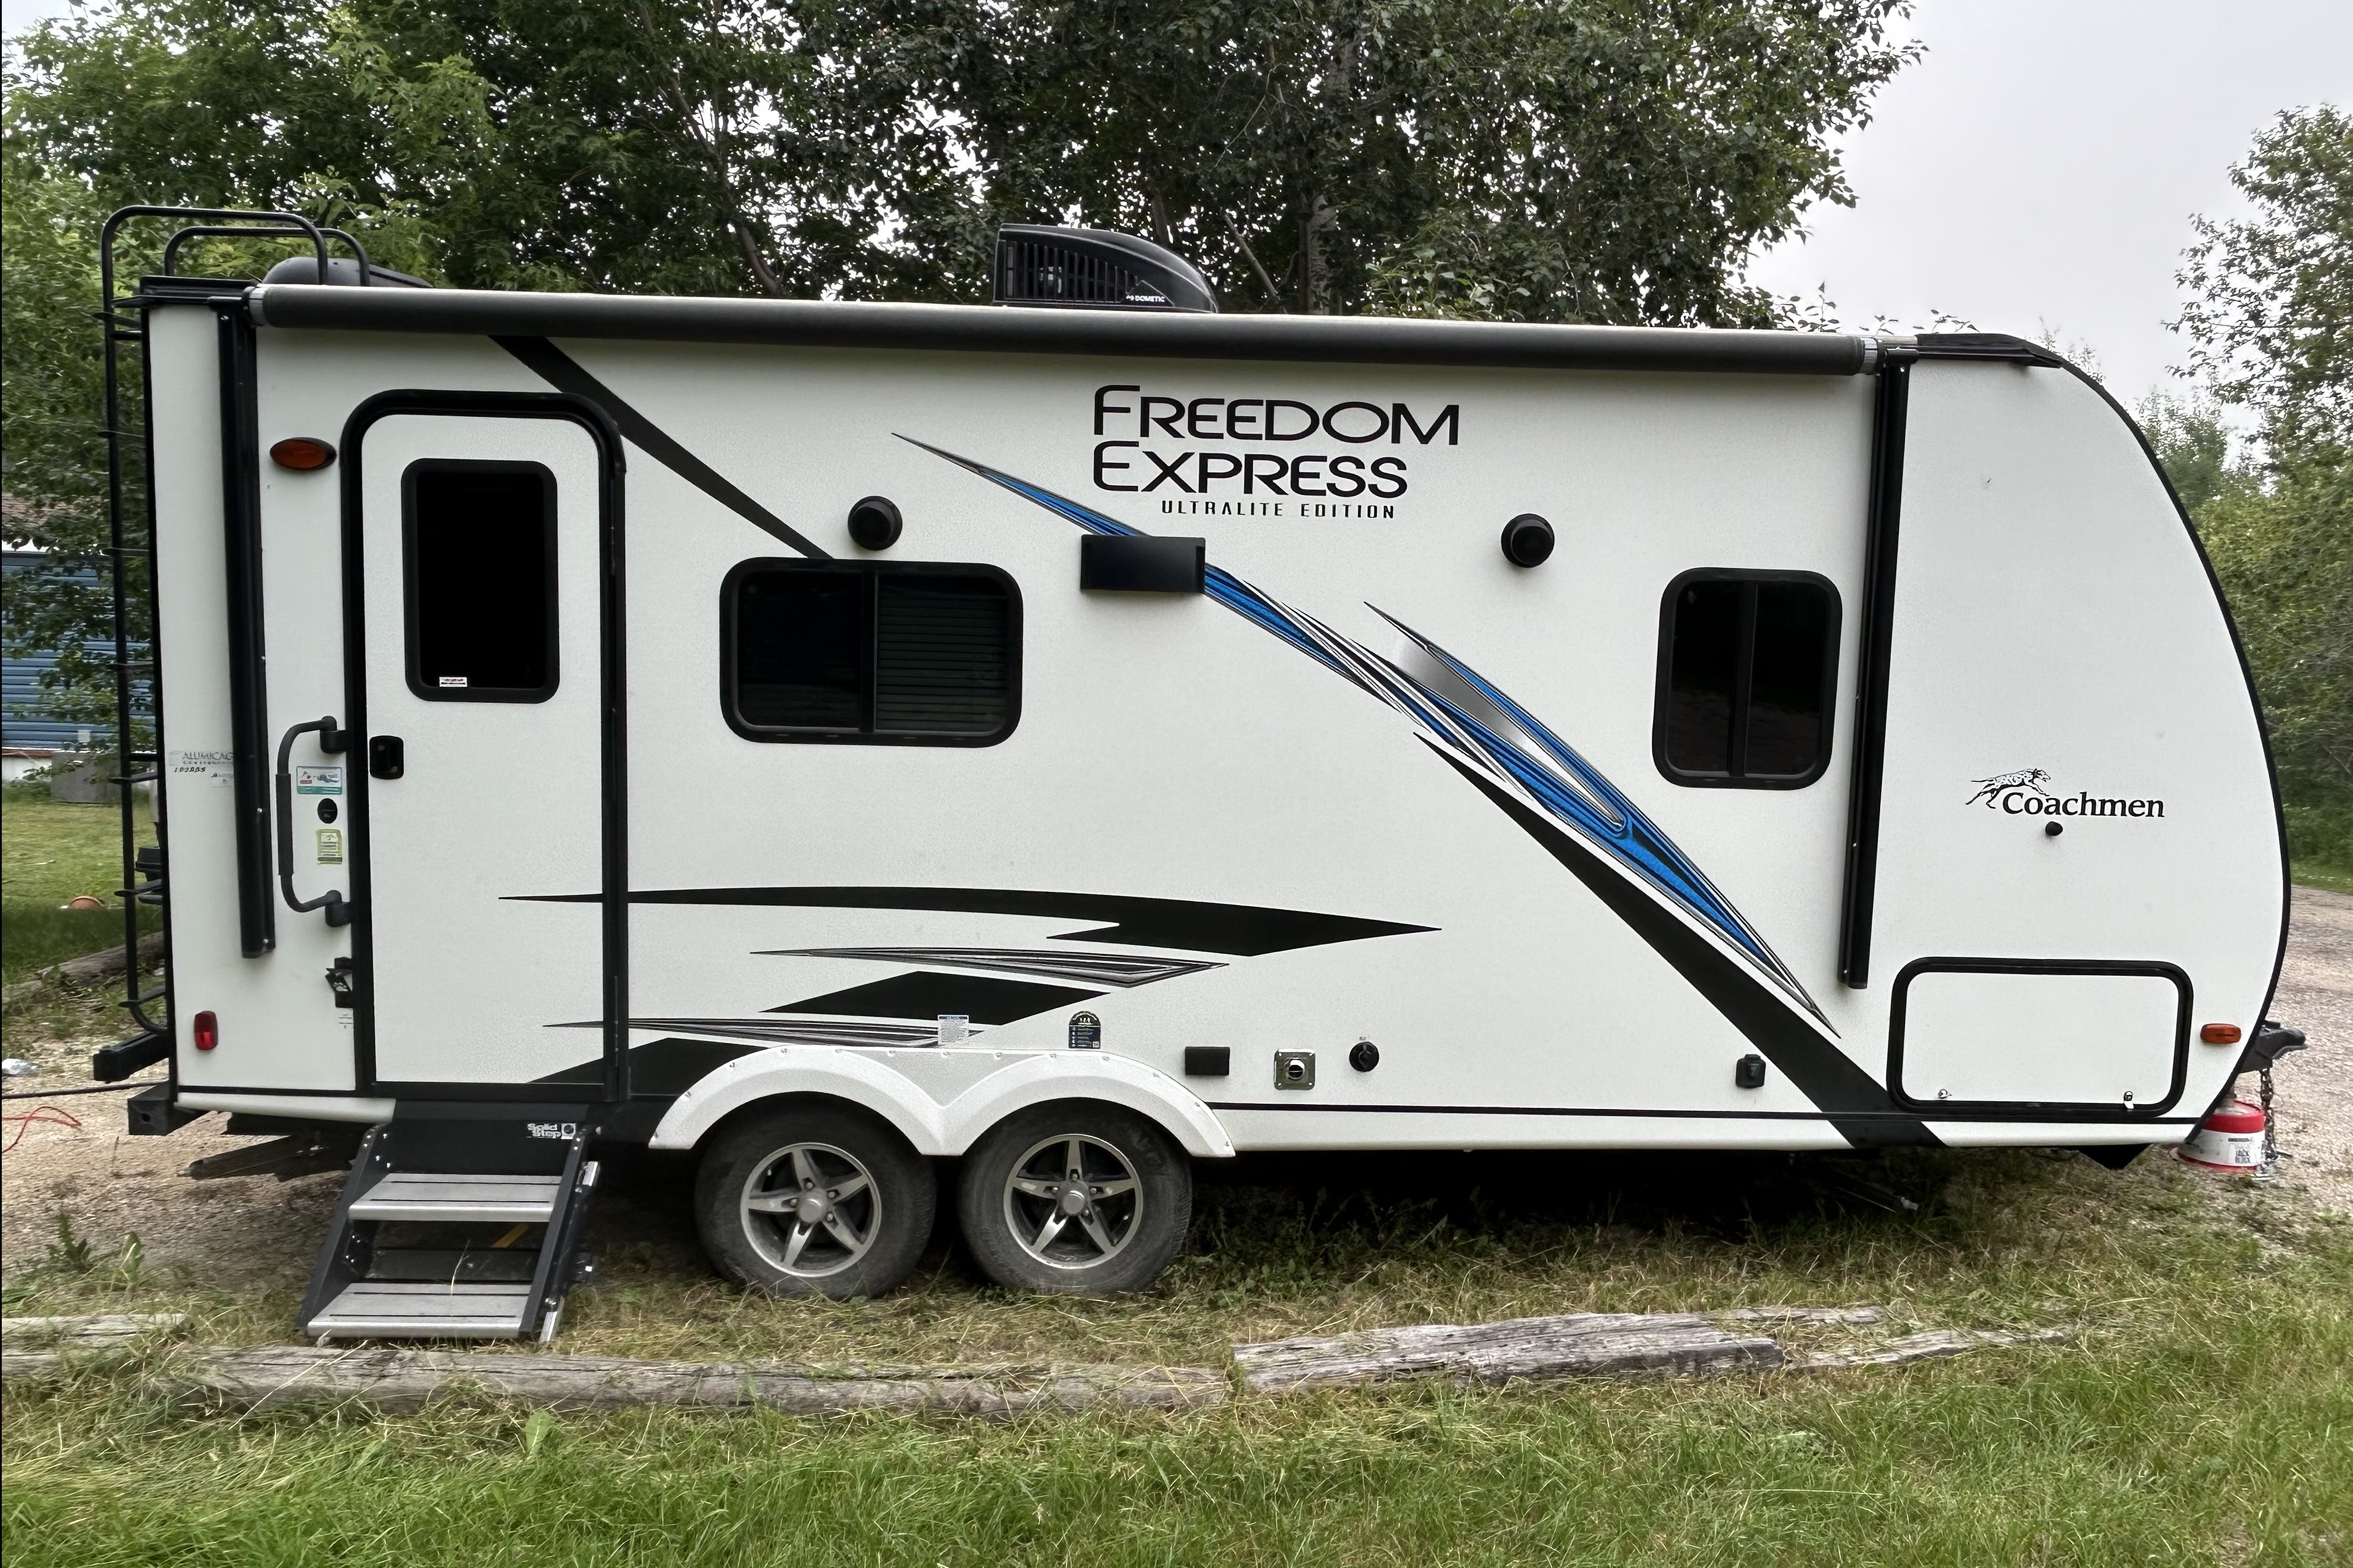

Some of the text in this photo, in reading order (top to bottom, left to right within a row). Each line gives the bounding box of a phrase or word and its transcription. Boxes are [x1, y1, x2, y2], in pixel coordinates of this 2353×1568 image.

[1094, 385, 1459, 445] FREEDOM
[1093, 441, 1408, 498] EXPRESS
[1162, 500, 1394, 519] ULTRALITE EDITION
[2002, 791, 2165, 818] Coachmen
